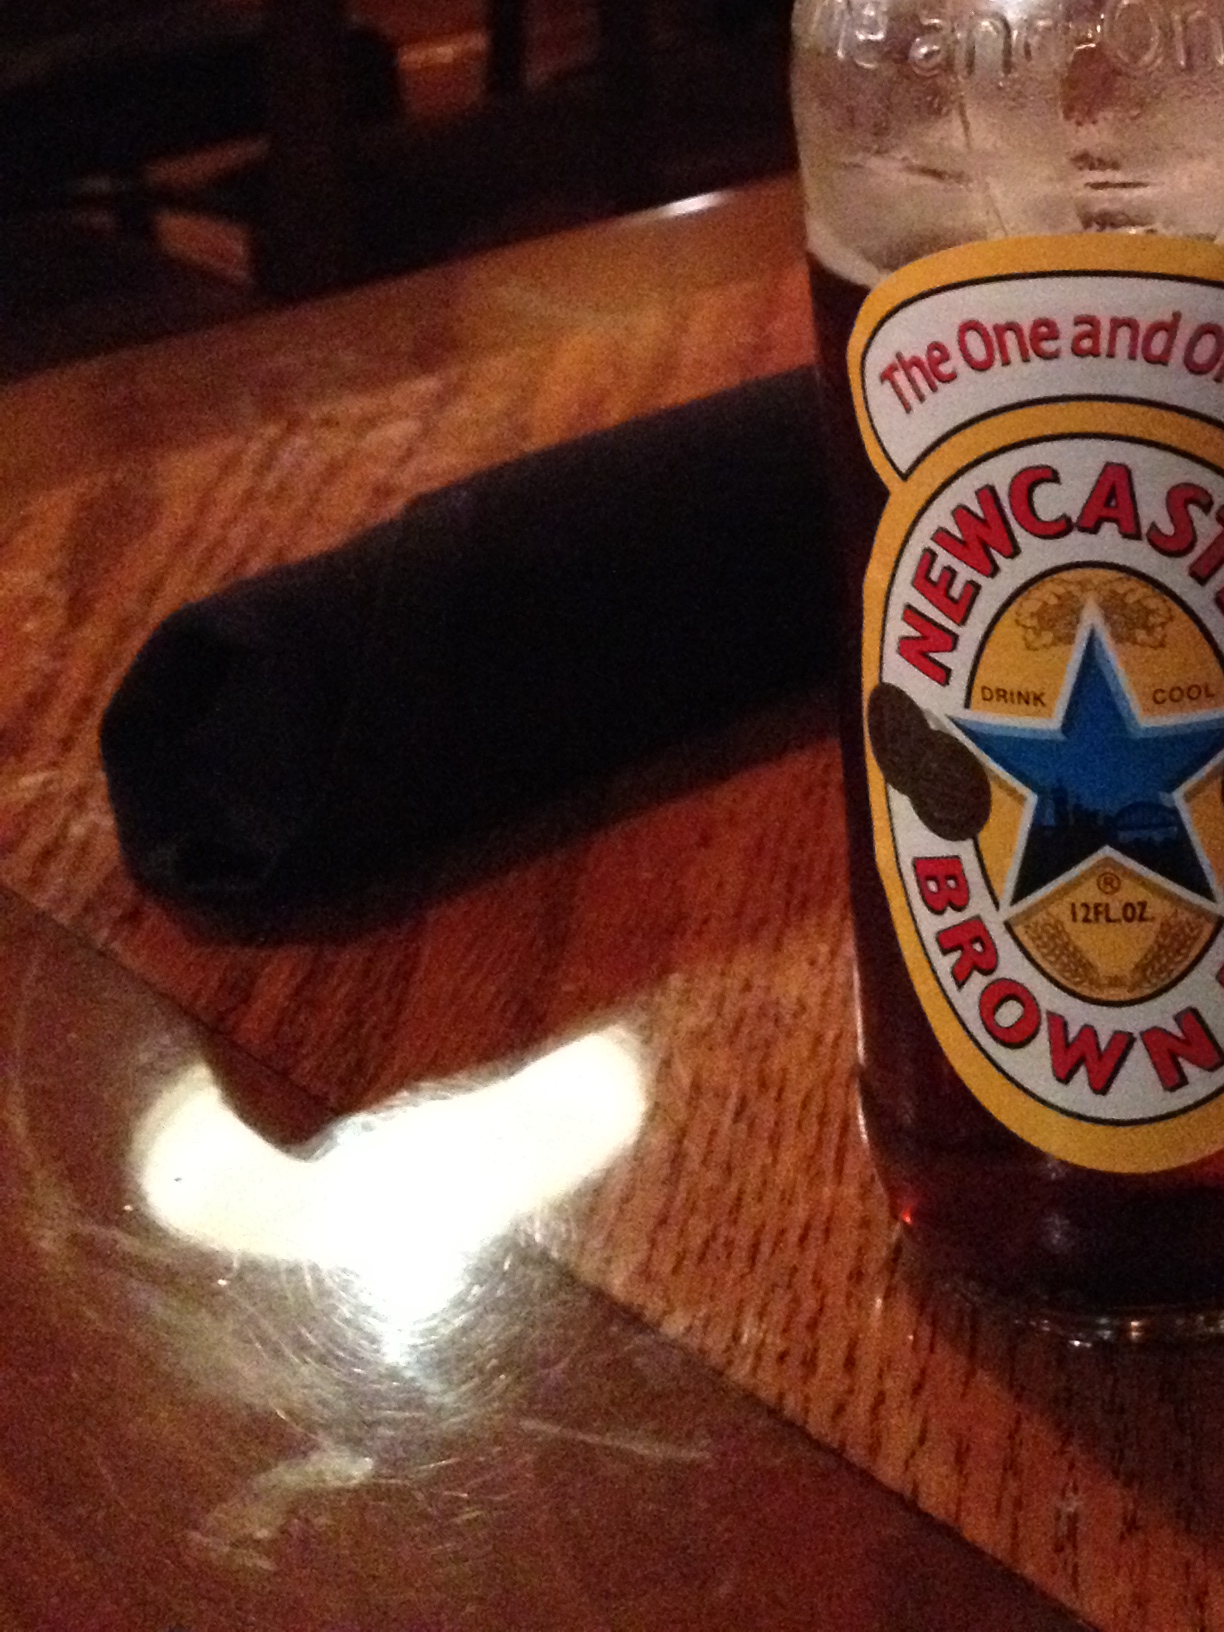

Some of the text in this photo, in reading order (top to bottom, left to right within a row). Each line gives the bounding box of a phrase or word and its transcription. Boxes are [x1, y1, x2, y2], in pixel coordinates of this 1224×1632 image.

[880, 340, 958, 414] The
[957, 316, 1061, 372] One
[1070, 310, 1183, 367] and
[981, 683, 1216, 708] DRINK COOL
